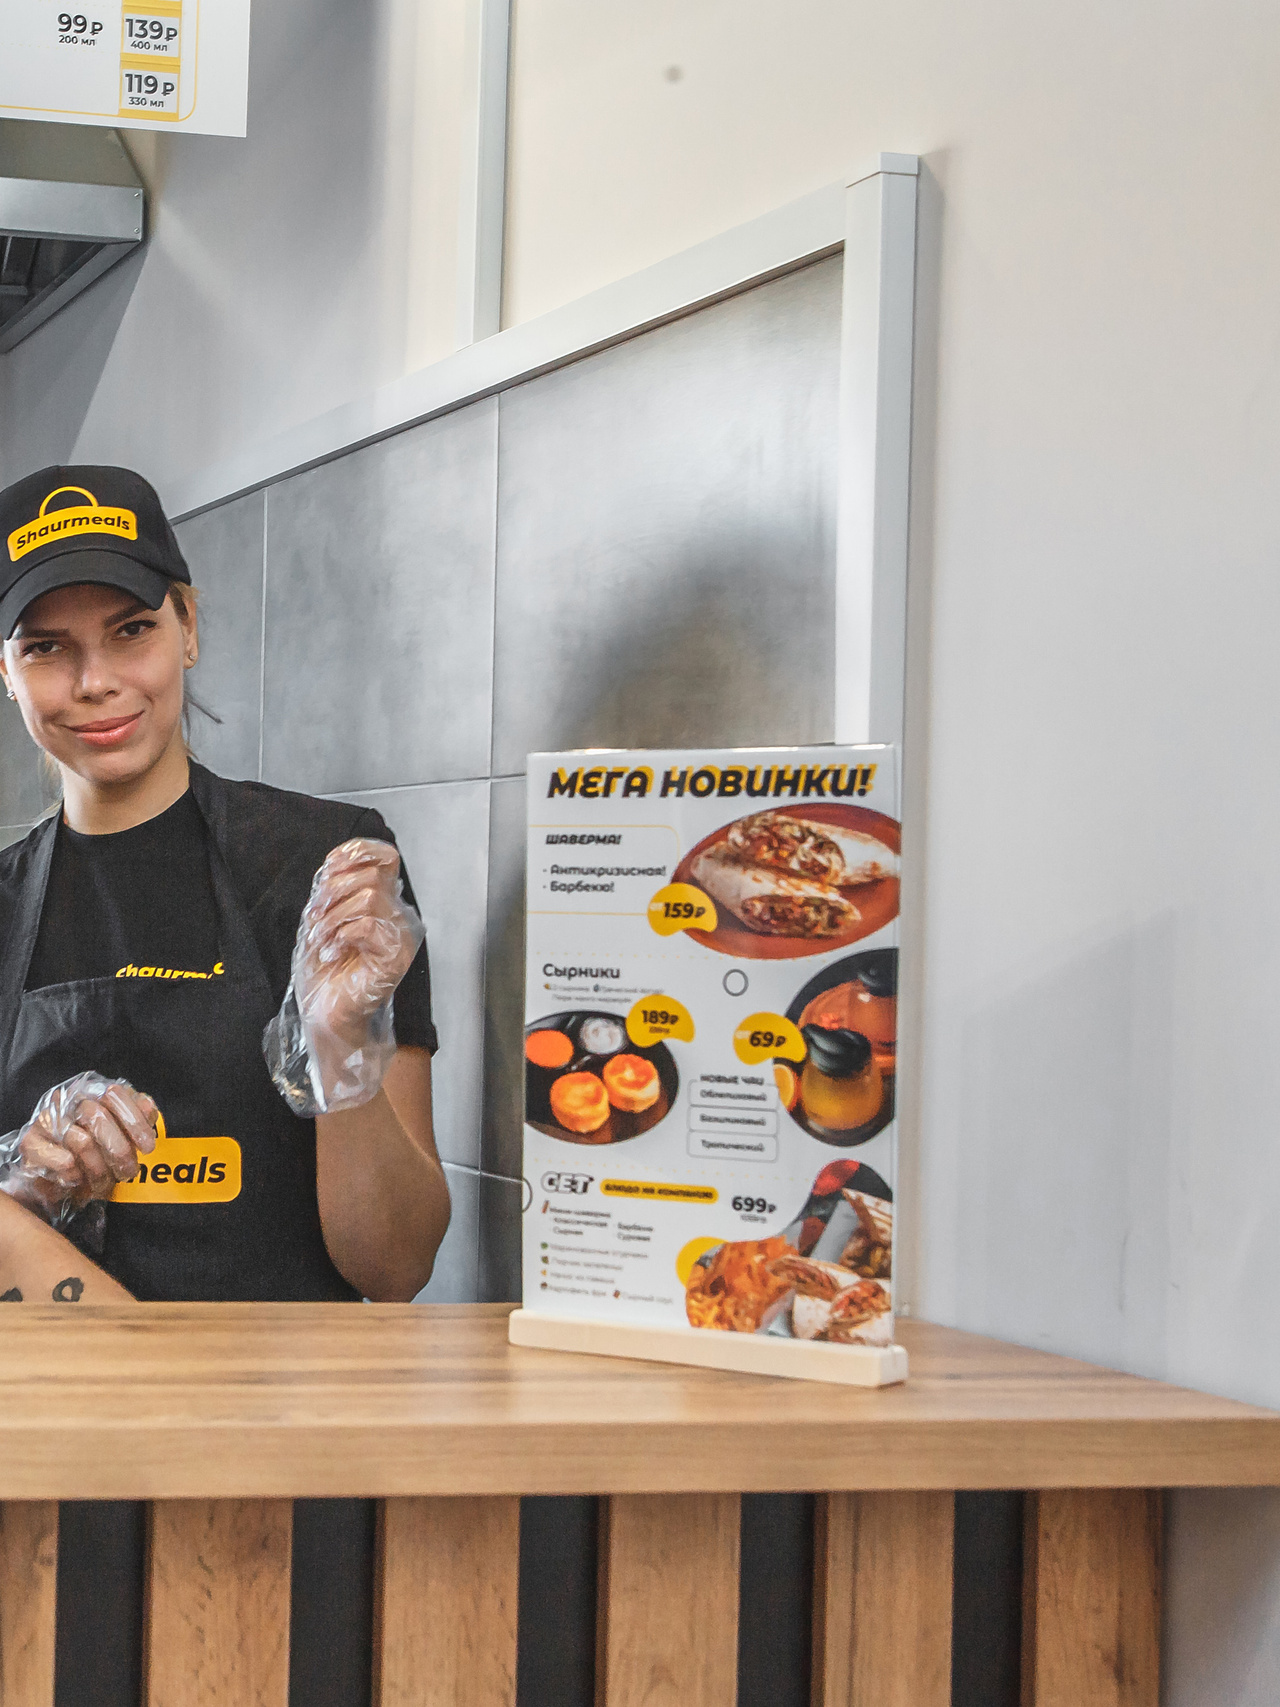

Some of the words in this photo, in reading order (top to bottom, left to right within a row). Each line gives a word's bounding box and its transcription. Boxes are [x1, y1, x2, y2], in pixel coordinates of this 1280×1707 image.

[58, 34, 78, 45] 200
[81, 38, 96, 47] мл
[130, 40, 151, 51] 400
[153, 44, 168, 53] мл
[128, 96, 147, 107] 330
[149, 99, 165, 109] мл
[16, 515, 131, 550] Shaurmeals
[547, 766, 655, 799] МЕГА
[659, 764, 878, 797] НОВИНКИ!
[546, 834, 622, 845] ШАВЕРМА!
[550, 864, 667, 877] Антикризисная!
[550, 880, 615, 894] Барбекю!
[543, 963, 621, 980] Сырники
